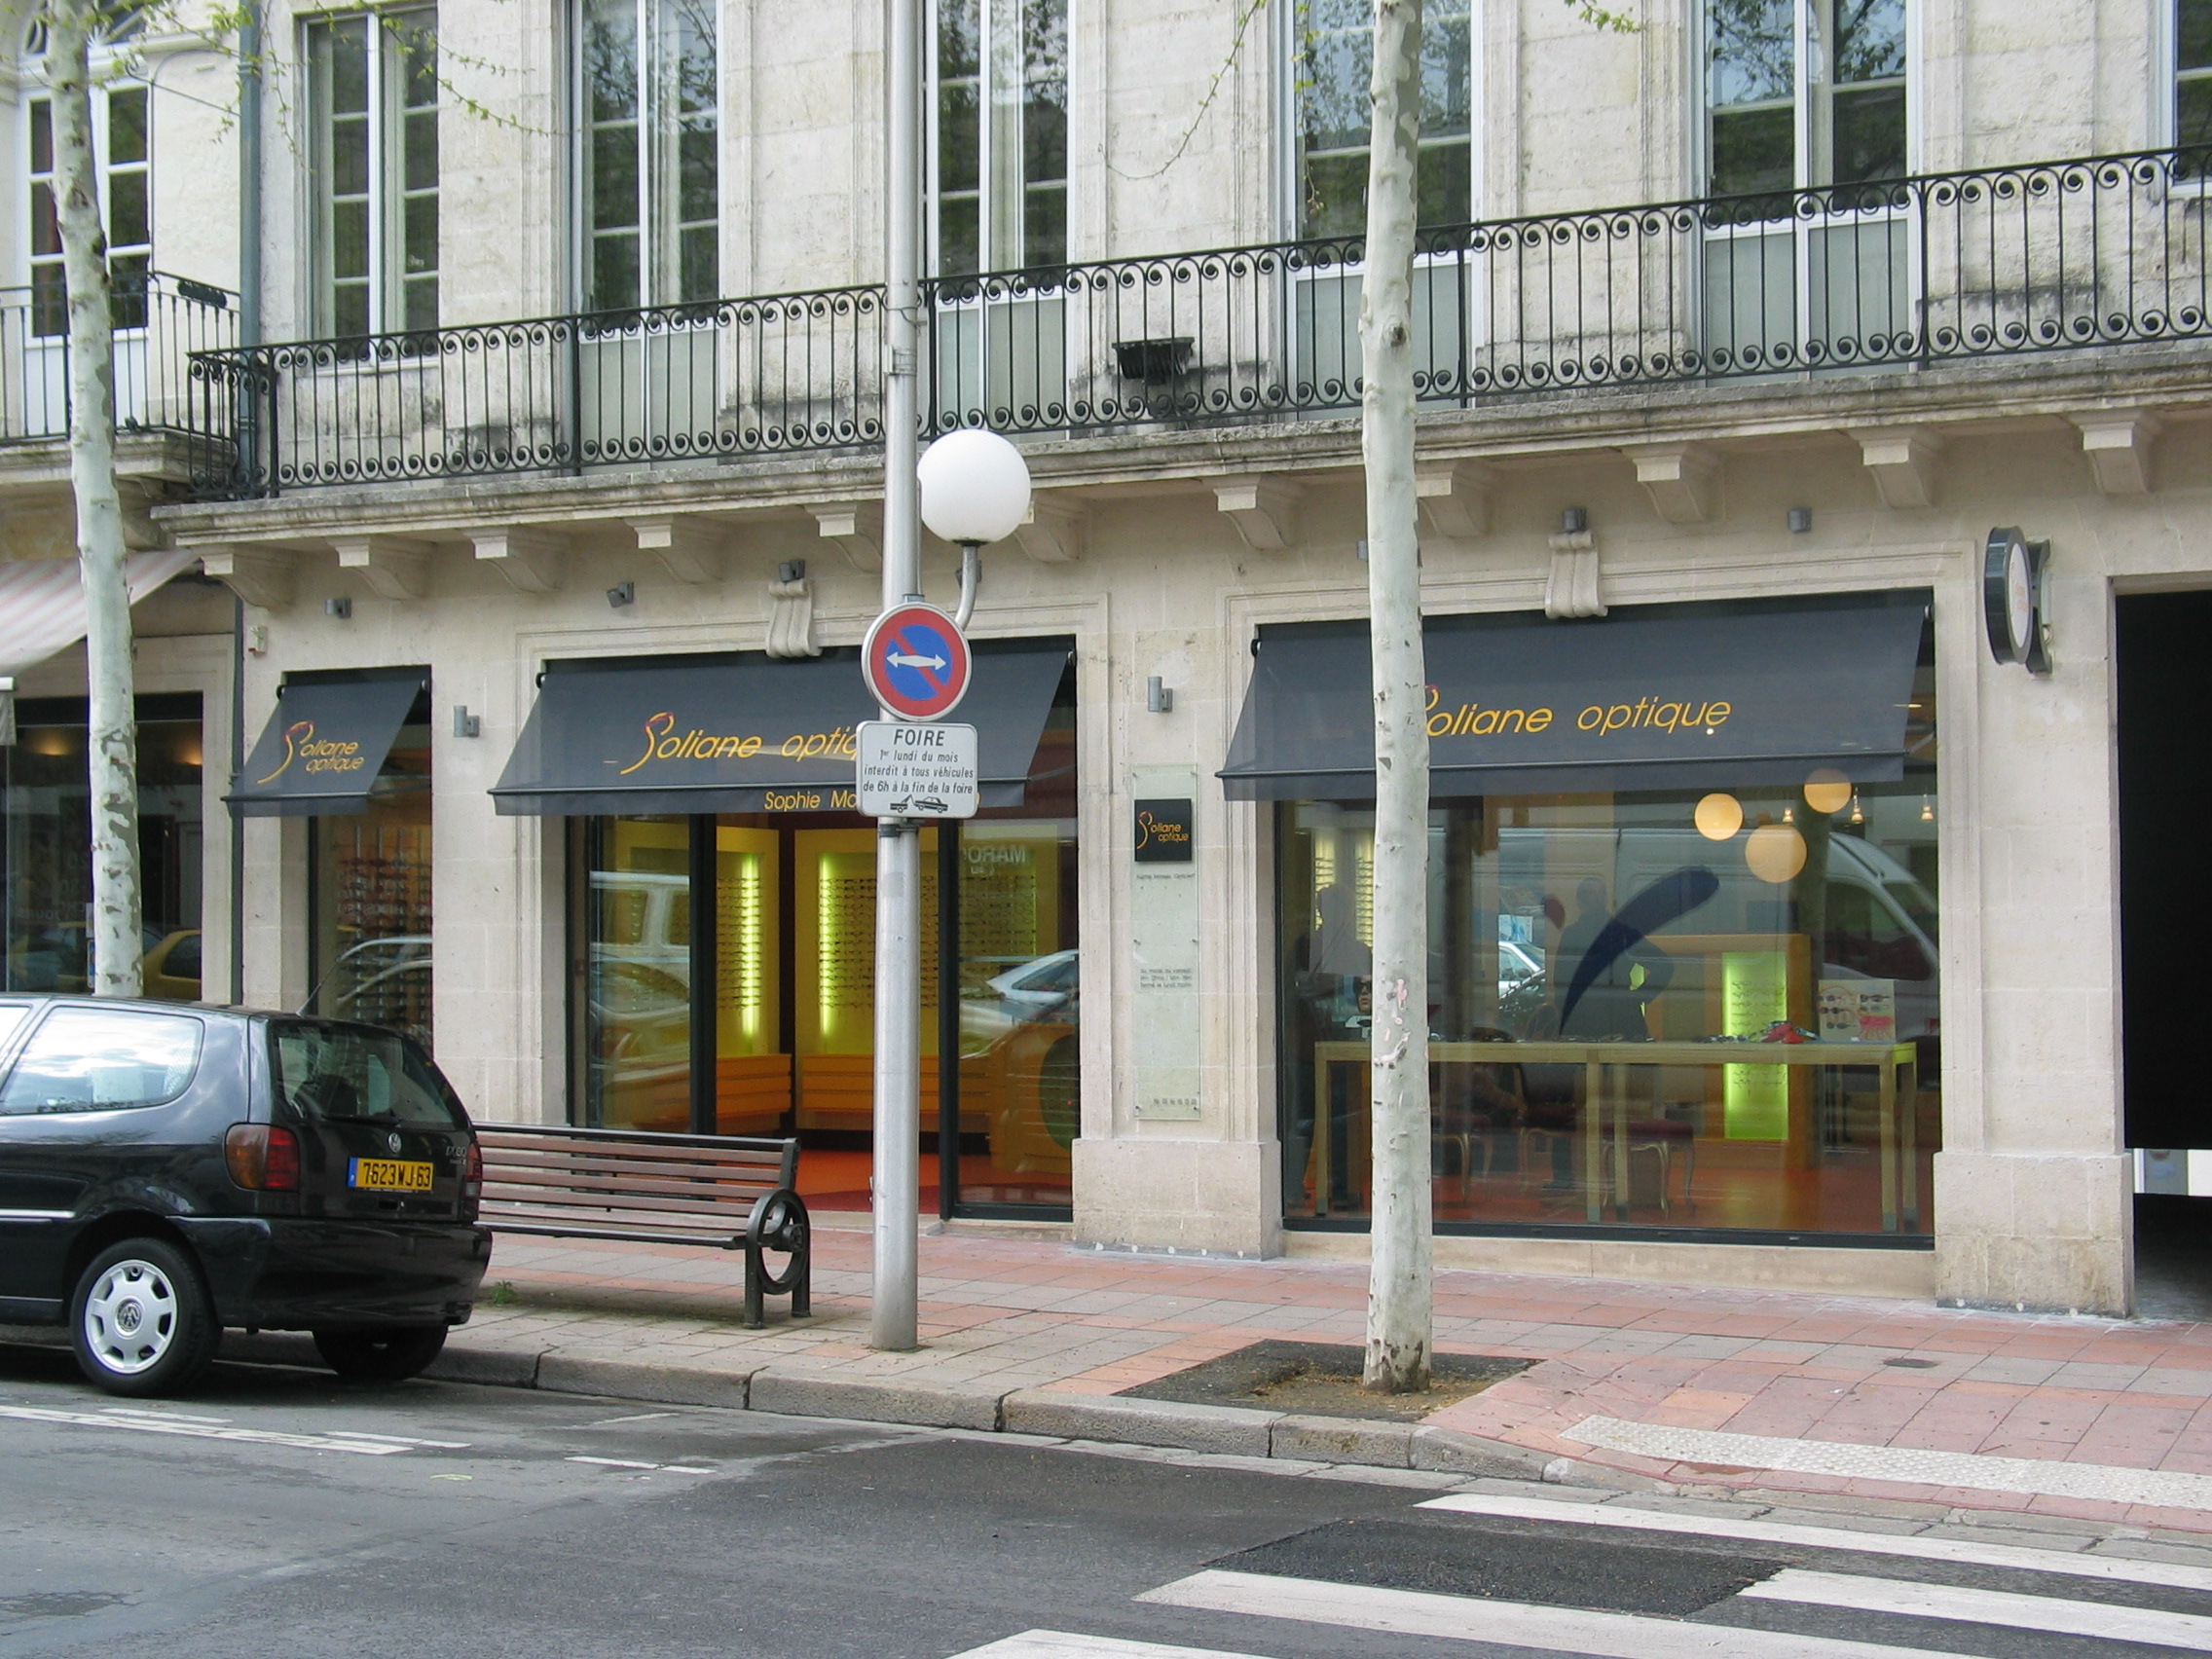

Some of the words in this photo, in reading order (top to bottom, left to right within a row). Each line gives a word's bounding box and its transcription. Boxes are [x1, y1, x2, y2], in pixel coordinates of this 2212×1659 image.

[1424, 684, 1555, 737] oliane
[1577, 695, 1733, 736] optique
[619, 711, 762, 775] Soliane
[781, 725, 858, 762] optiq
[894, 728, 945, 747] FOIRE
[257, 720, 360, 785] Soliane
[894, 750, 917, 761] lundi
[921, 751, 933, 762] du
[937, 752, 959, 763] mois
[305, 755, 364, 775] optique
[864, 764, 899, 777] interdit
[911, 766, 930, 778] tous
[933, 766, 974, 779] véhicules
[863, 780, 874, 793] de
[877, 780, 889, 793] 6h
[901, 781, 909, 793] la
[912, 781, 925, 793] fin
[928, 781, 940, 793] de
[941, 782, 950, 793] la
[952, 782, 974, 794] foire
[764, 791, 822, 812] Sophie
[363, 1161, 397, 1186] 7623
[417, 1165, 431, 1187] 63
